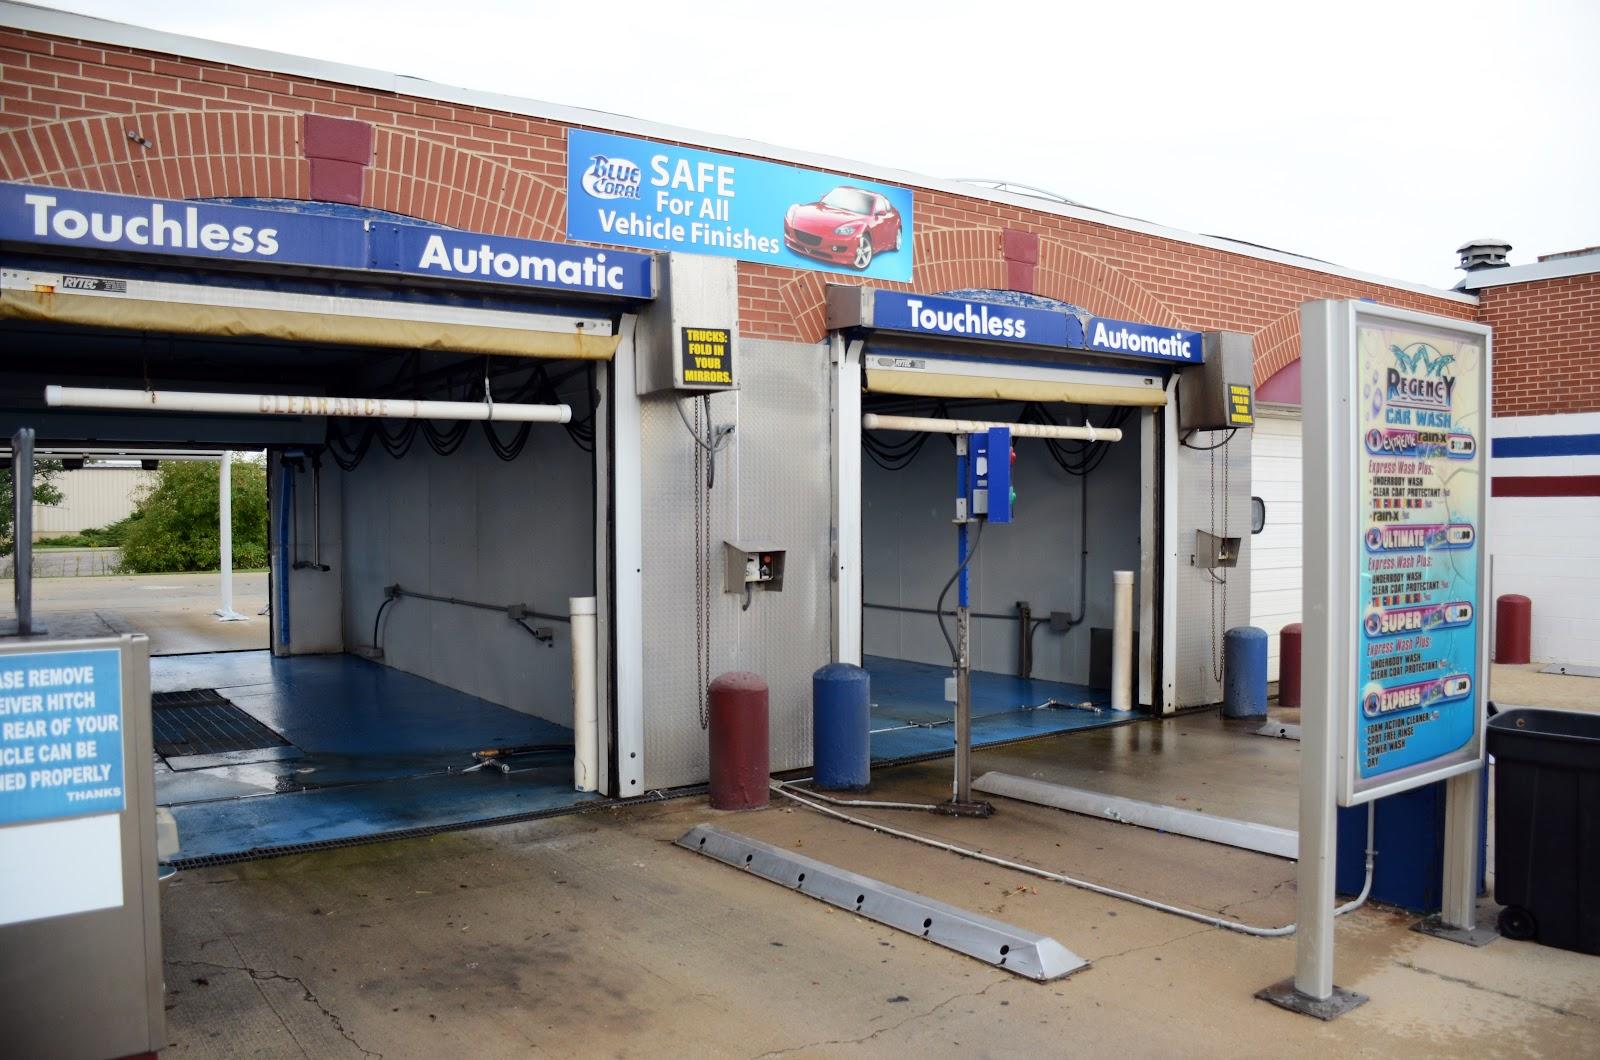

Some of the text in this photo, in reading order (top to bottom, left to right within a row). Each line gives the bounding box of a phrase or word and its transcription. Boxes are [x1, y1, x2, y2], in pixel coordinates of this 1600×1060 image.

[591, 155, 640, 182] BLUE
[651, 155, 735, 198] SAFE
[593, 178, 640, 200] CORAL
[656, 191, 729, 222] For All
[25, 194, 279, 256] Touchless
[599, 209, 780, 254] Vehicle Finishes
[418, 234, 624, 290] Automatic
[63, 277, 99, 290] RYTEC
[907, 300, 1026, 339] Touchless
[687, 329, 728, 343] TRUCKS:
[1093, 322, 1191, 358] Automatic
[689, 343, 724, 356] FOLD IN
[695, 357, 721, 369] YOUR
[685, 370, 732, 383] MIRRORS.
[1387, 367, 1455, 406] REGENCY
[258, 395, 389, 416] CLEARANCE
[1385, 407, 1452, 428] CAR WASH
[1383, 434, 1416, 454] EXTREME
[1368, 459, 1396, 475] Express
[1399, 461, 1416, 475] Wash
[1373, 477, 1423, 486] UNDERBODY WASH
[1373, 487, 1390, 497] CLEAR
[1391, 488, 1405, 497] COAT
[1407, 488, 1441, 498] PROTECTANT
[1382, 529, 1425, 549] ULTIMATE
[1368, 557, 1395, 572] Express
[1397, 555, 1414, 570] Wash
[1372, 571, 1422, 584] UNDERBODY WASH
[1372, 584, 1389, 596] CLEAR
[1390, 583, 1404, 594] COAT
[1406, 581, 1439, 592] PROTECTANT
[1381, 611, 1422, 633] SUPER
[1367, 641, 1394, 657] Express
[1395, 638, 1413, 653] Wash
[1371, 653, 1421, 669] UNDERBODY WASH
[1371, 669, 1388, 681] CLEAR
[1389, 666, 1403, 678] COAT
[1405, 661, 1438, 674] PROTECTANT
[29, 667, 94, 687] REMOVE
[47, 691, 96, 711] HITCH
[1380, 687, 1421, 712] EXPRESS
[3, 714, 119, 740] REAR OF YOUR
[1367, 733, 1382, 746] SPOT
[1399, 726, 1414, 738] RINSE
[1368, 723, 1383, 735] FOAM
[1384, 717, 1405, 731] ACTION
[38, 743, 72, 762] CAN
[76, 741, 97, 758] BE
[1389, 739, 1406, 752] WASH
[1367, 756, 1379, 768] DRY
[31, 764, 112, 788] PROPERLY
[66, 786, 122, 802] THANKS
